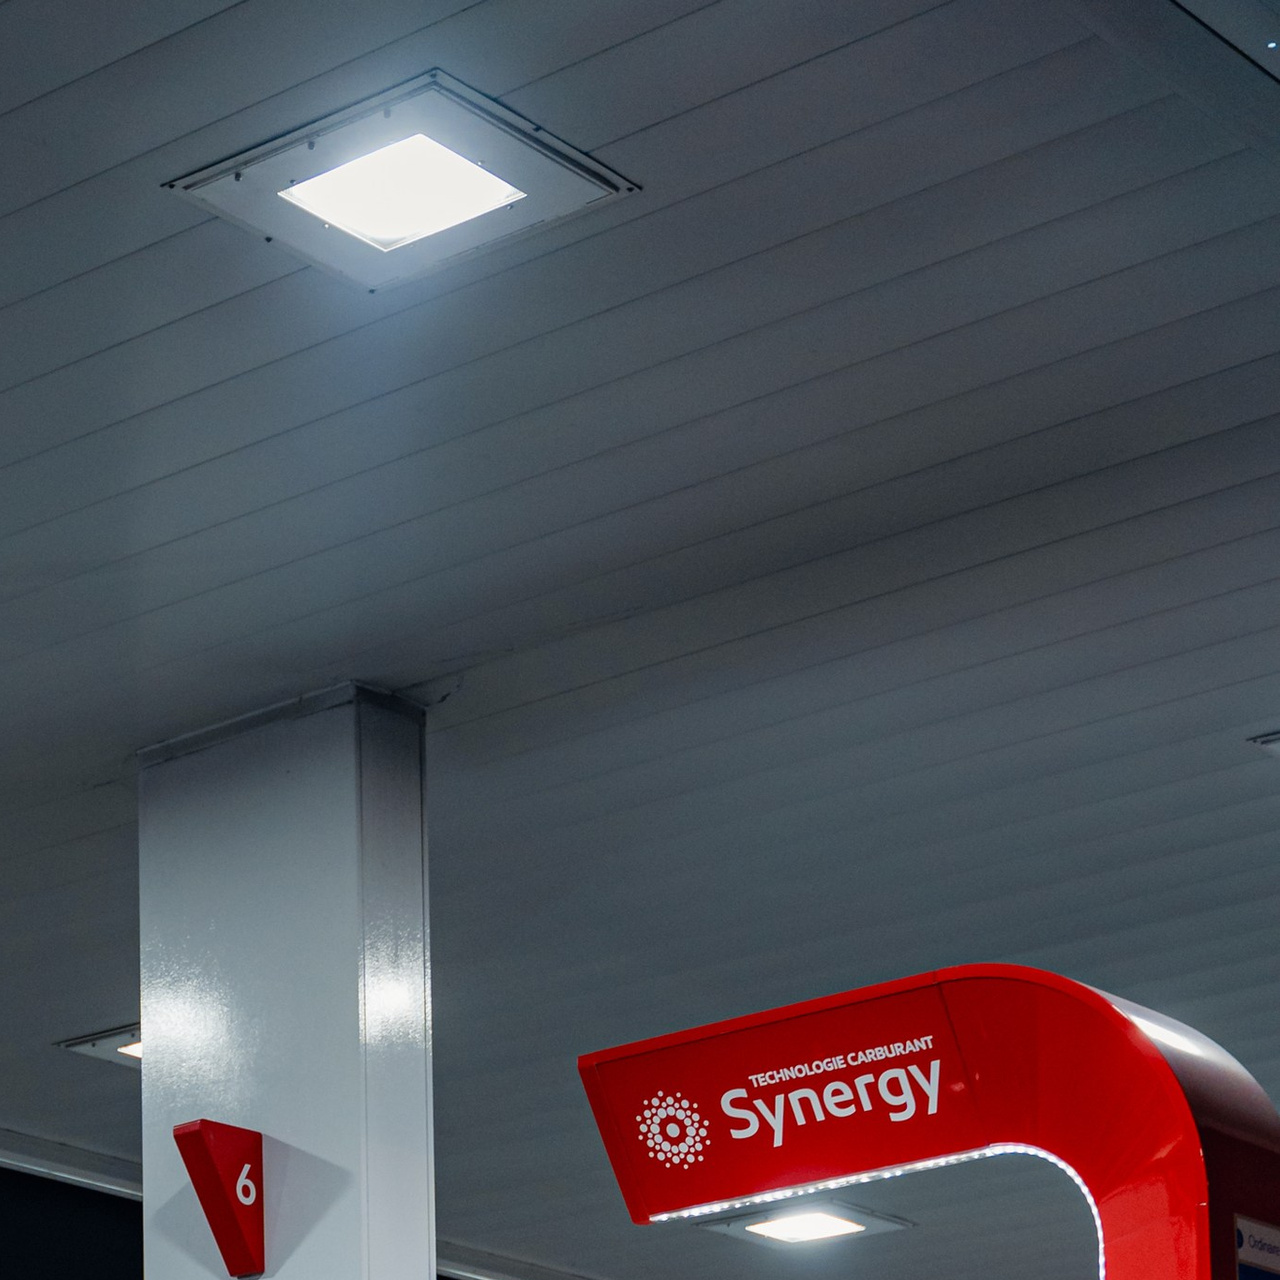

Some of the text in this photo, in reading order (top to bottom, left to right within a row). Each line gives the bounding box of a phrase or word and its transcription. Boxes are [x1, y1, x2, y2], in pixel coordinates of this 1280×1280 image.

[748, 1035, 933, 1088] TECHNOLOGIE CARBURANT
[720, 1059, 941, 1148] Synergy
[236, 1163, 257, 1206] 6
